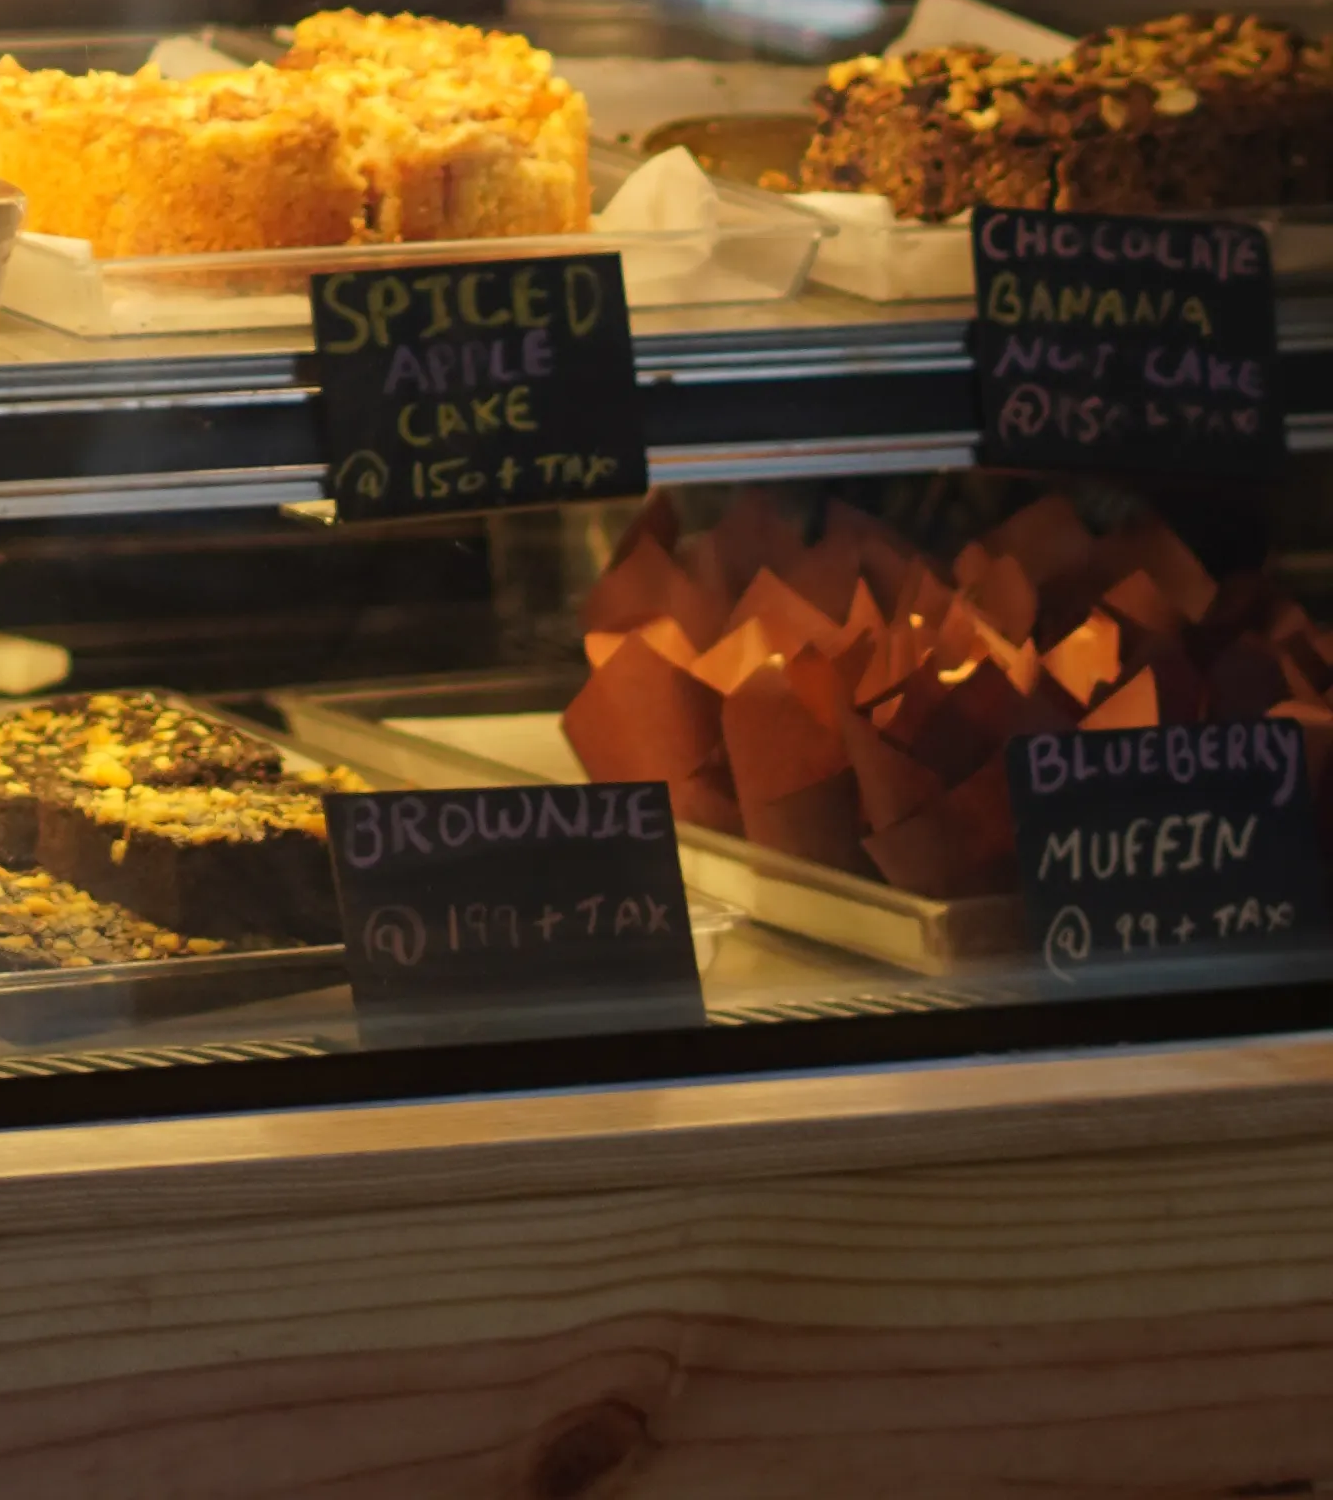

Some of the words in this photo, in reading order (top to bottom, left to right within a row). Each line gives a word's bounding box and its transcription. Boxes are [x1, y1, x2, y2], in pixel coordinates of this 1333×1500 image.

[981, 213, 1260, 281] CHOCOLATE
[323, 264, 603, 354] SPICED
[988, 270, 1212, 336] BANANA
[397, 386, 539, 446] CAKE
[1028, 722, 1299, 806] BLUEBERRY
[344, 786, 666, 868] BROWNIE
[1037, 809, 1258, 881] MUFFIN
